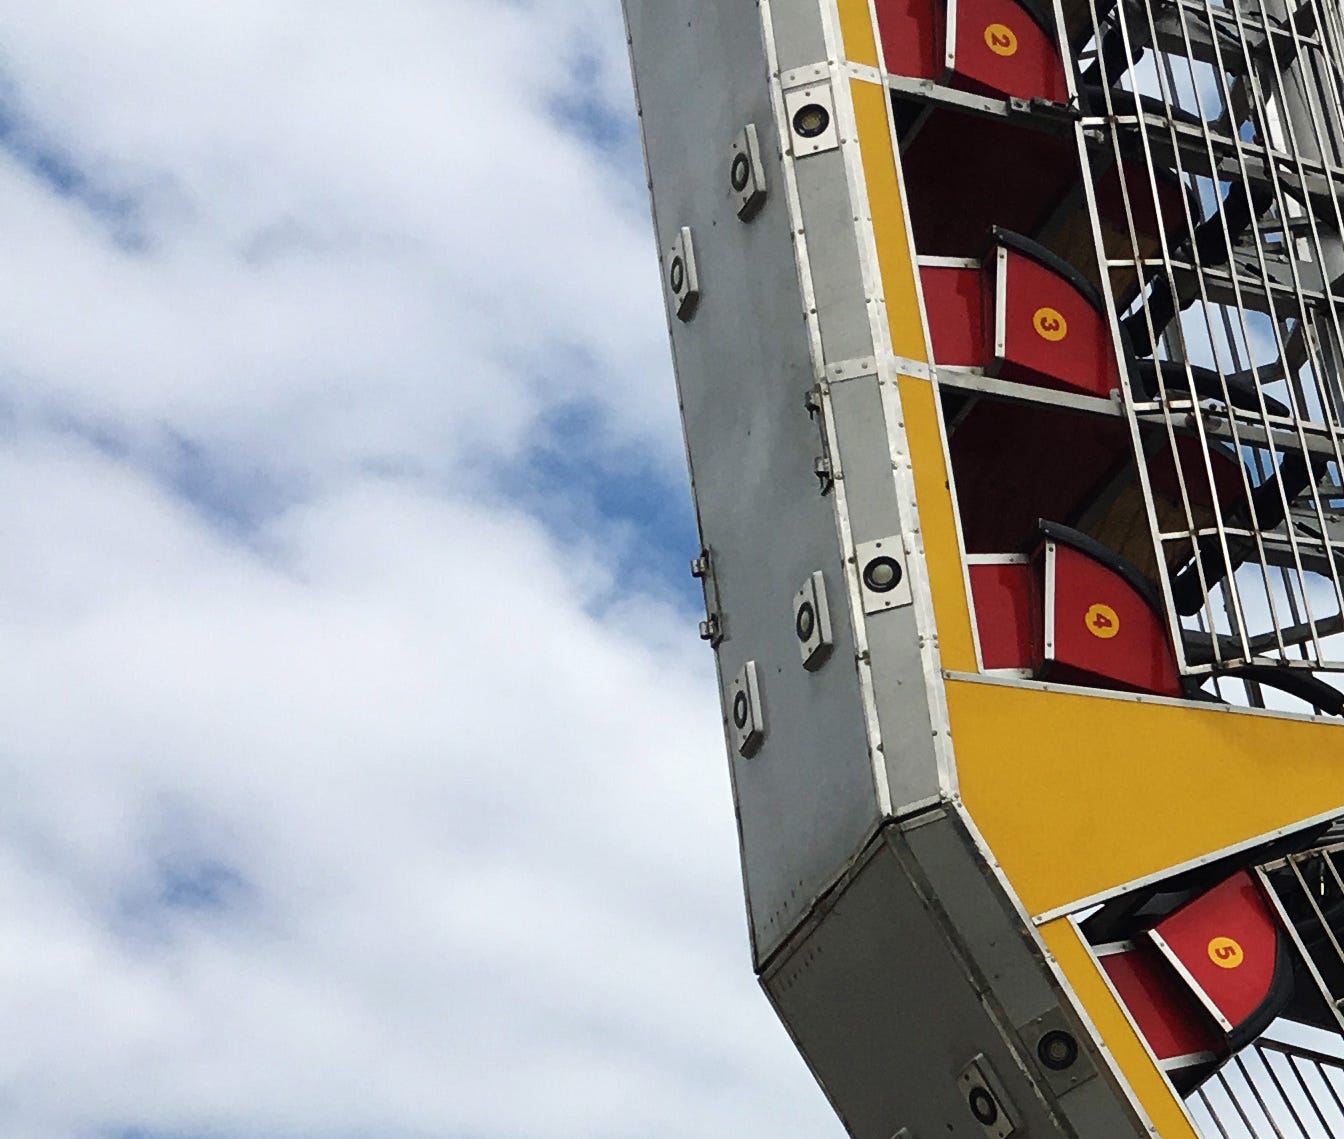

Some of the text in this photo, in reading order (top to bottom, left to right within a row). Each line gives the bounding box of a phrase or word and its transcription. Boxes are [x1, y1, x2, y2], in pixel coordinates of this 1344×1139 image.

[990, 32, 1012, 49] 2
[1038, 315, 1062, 332] 3
[1091, 612, 1113, 629] 4
[1214, 945, 1237, 961] 5
